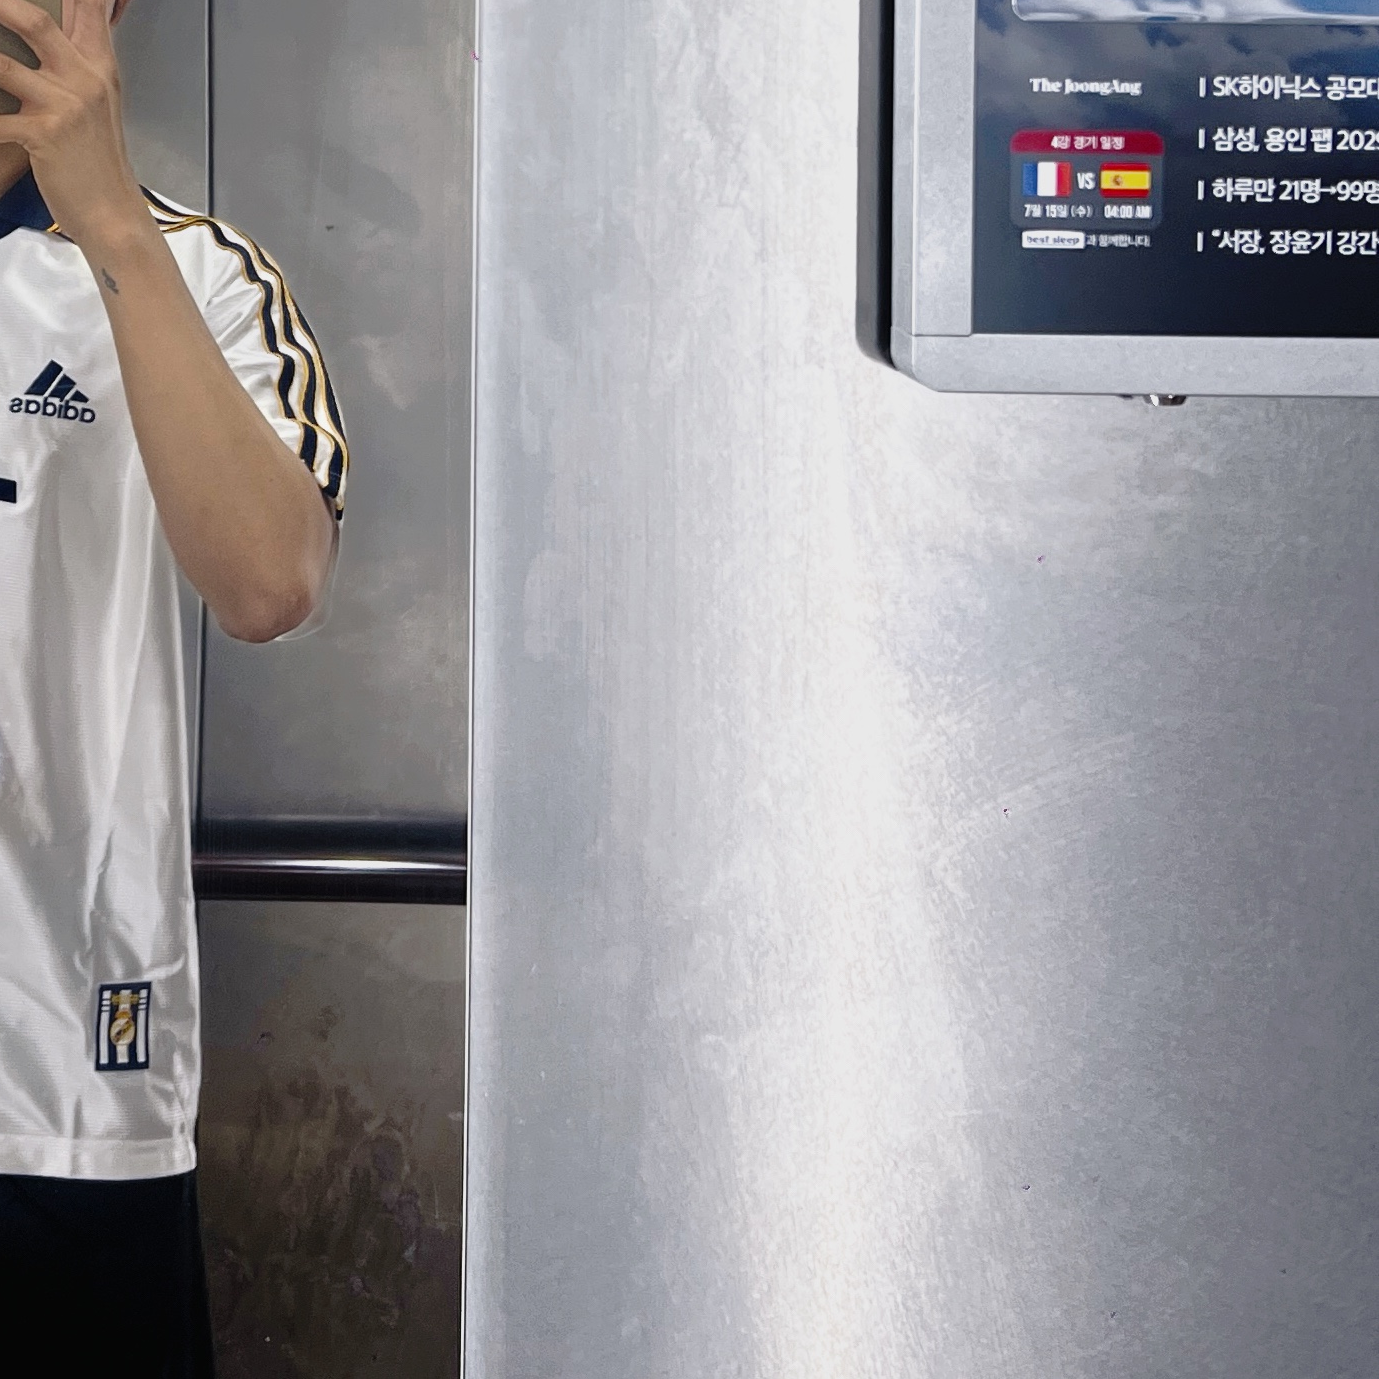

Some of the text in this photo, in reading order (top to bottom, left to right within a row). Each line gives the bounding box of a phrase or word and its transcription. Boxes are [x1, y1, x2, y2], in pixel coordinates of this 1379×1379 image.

[1029, 77, 1142, 96] The JoongAng
[1212, 74, 1322, 100] SK하이닉스
[1212, 126, 1260, 152] 삼성,
[1264, 127, 1307, 152] 용인
[1310, 127, 1333, 153] 팹
[1212, 177, 1276, 203] 하루만
[1269, 230, 1333, 256] 장윤기
